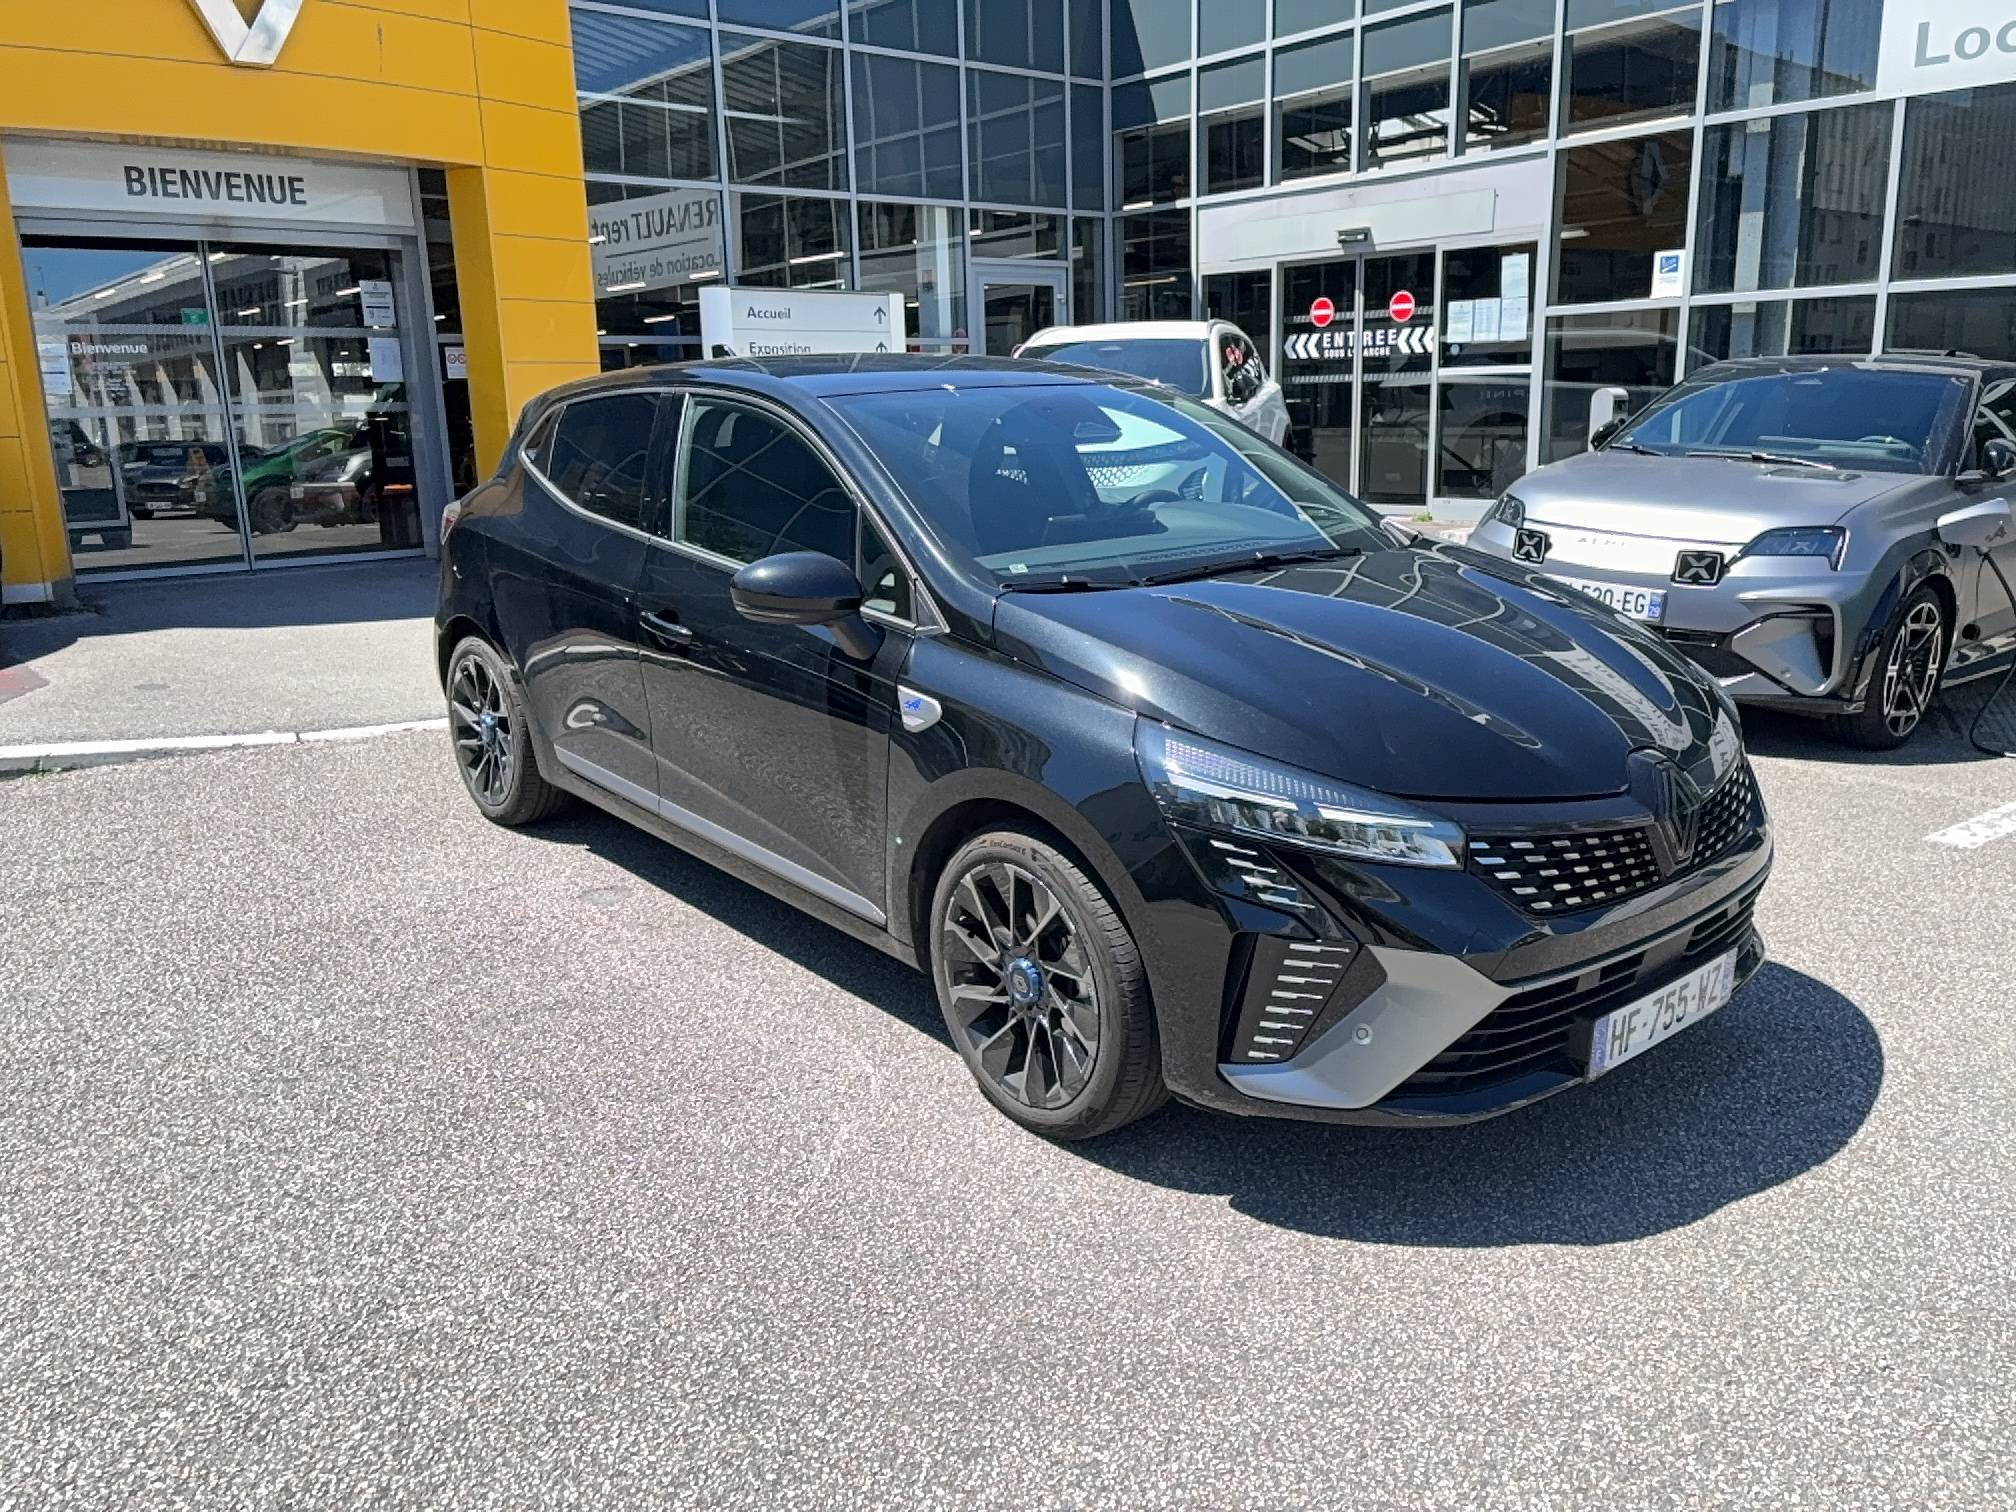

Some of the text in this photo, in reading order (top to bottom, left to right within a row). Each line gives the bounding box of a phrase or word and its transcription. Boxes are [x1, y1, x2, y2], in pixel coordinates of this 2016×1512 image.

[123, 165, 307, 206] BIENVENUE
[747, 306, 791, 319] Accueil
[70, 341, 148, 355] Bienvenue
[749, 341, 811, 354] Exposition
